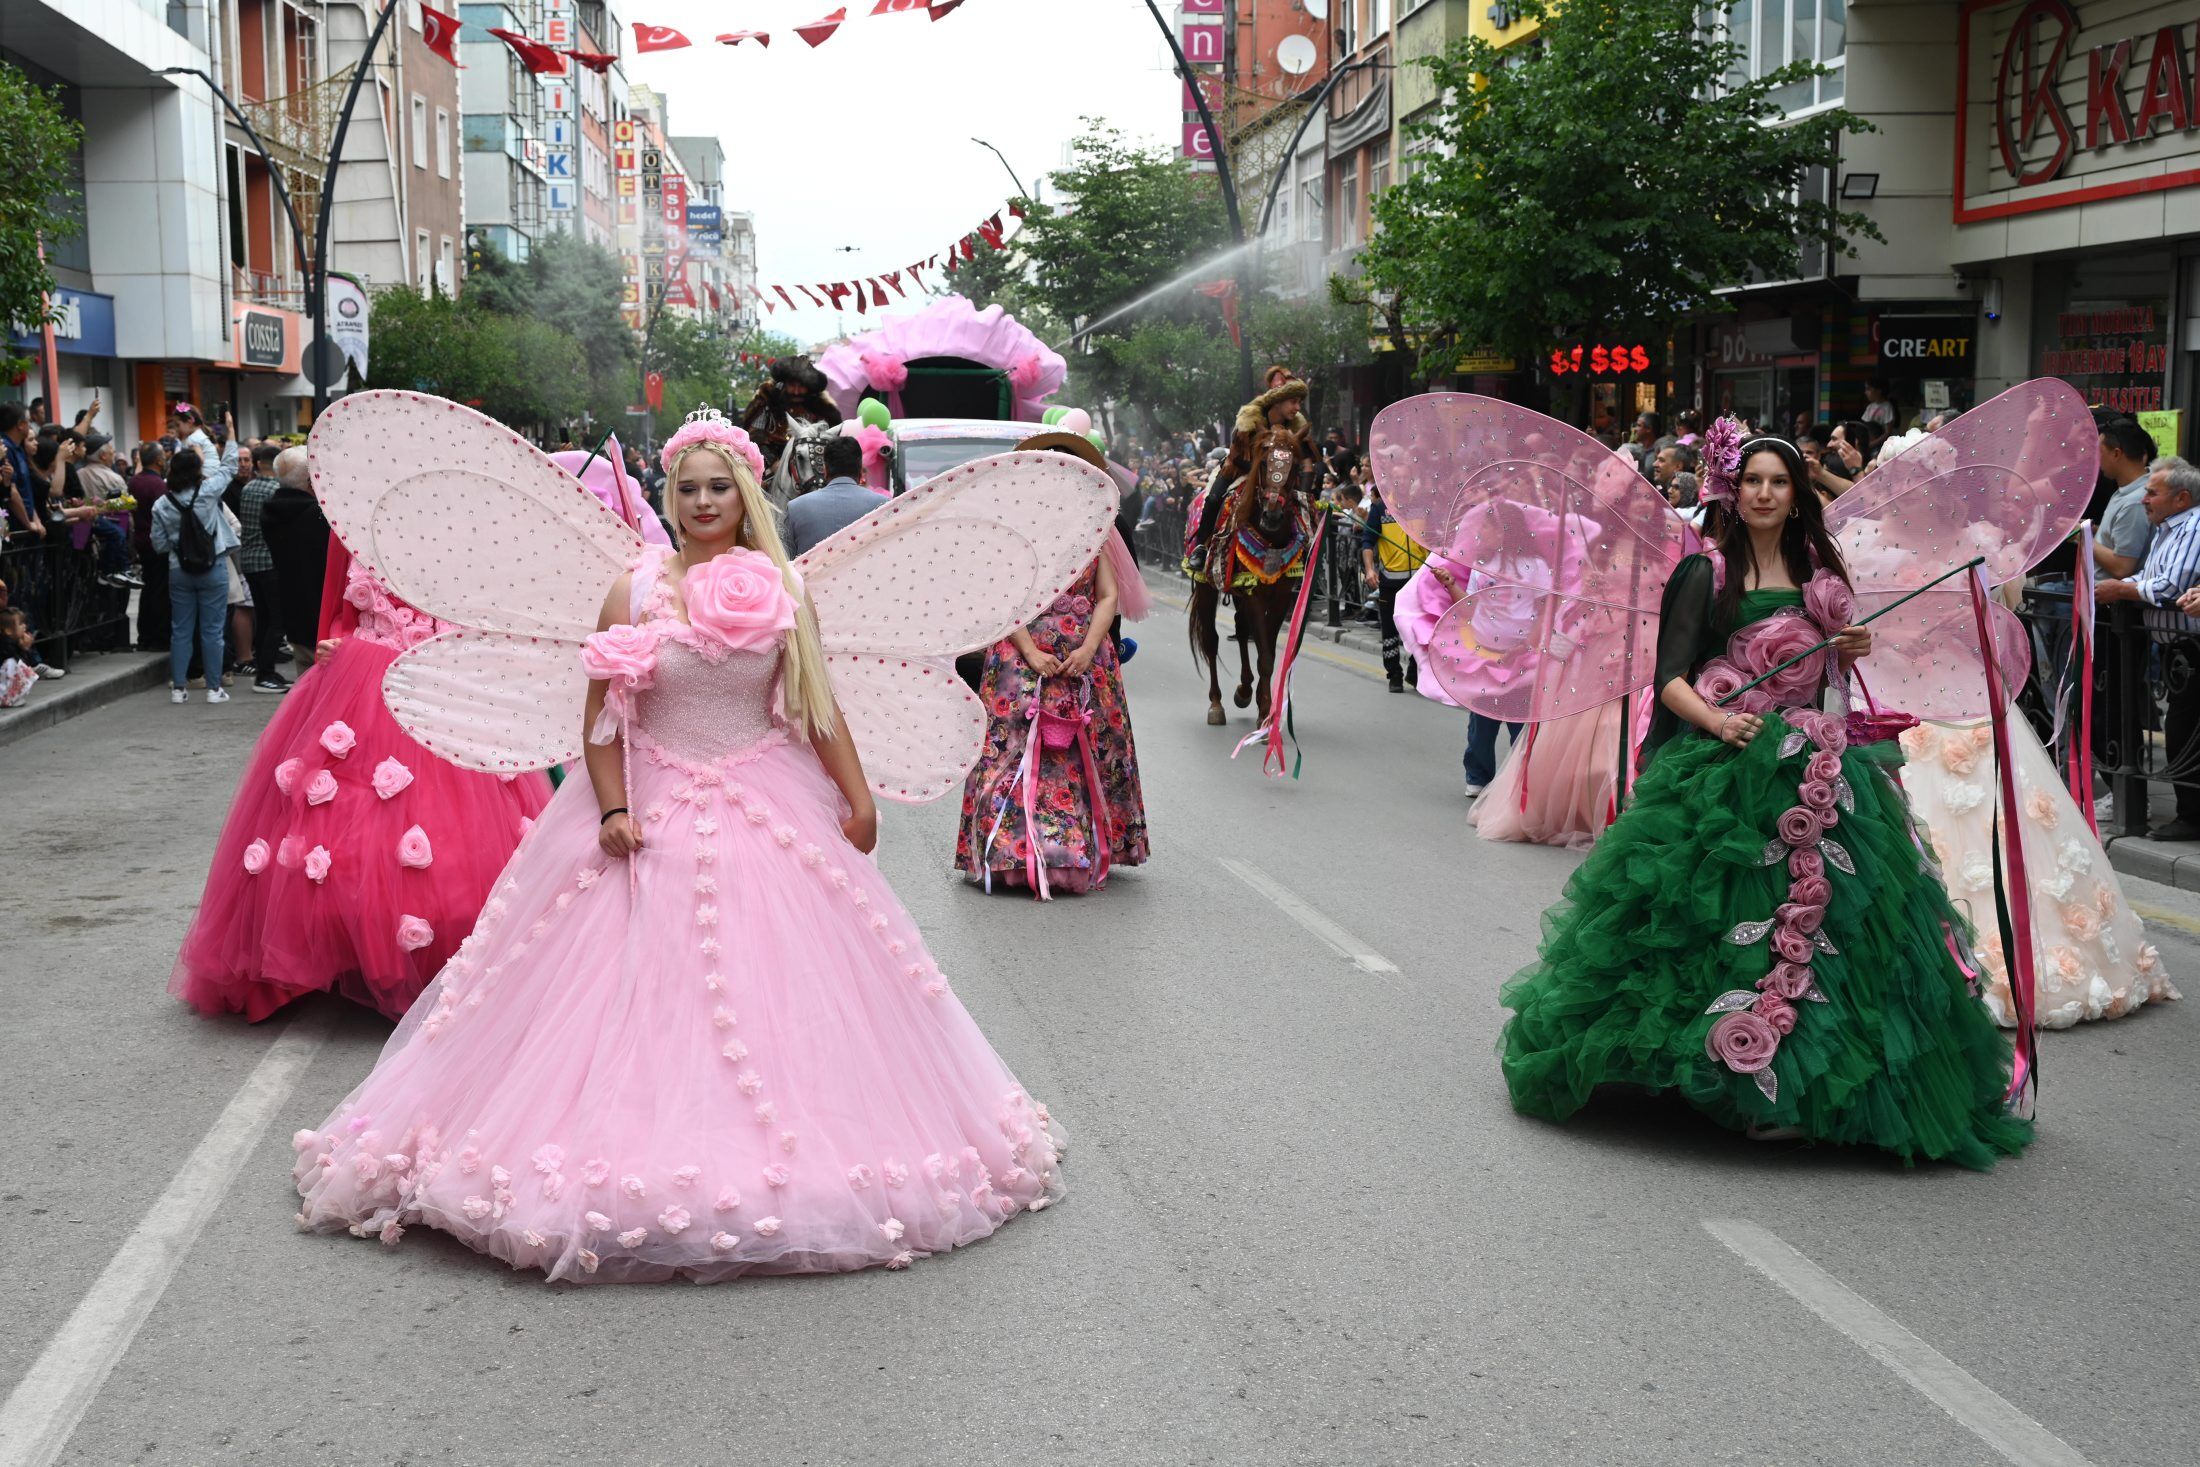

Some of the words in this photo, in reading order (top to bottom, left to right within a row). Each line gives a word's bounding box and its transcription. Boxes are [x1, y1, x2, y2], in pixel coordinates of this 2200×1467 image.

[2086, 17, 2200, 150] KA
[616, 122, 635, 224] OTEL
[689, 211, 717, 220] hedef
[1884, 338, 1970, 358] CREART
[2128, 340, 2145, 374] 18
[2145, 345, 2168, 373] AY
